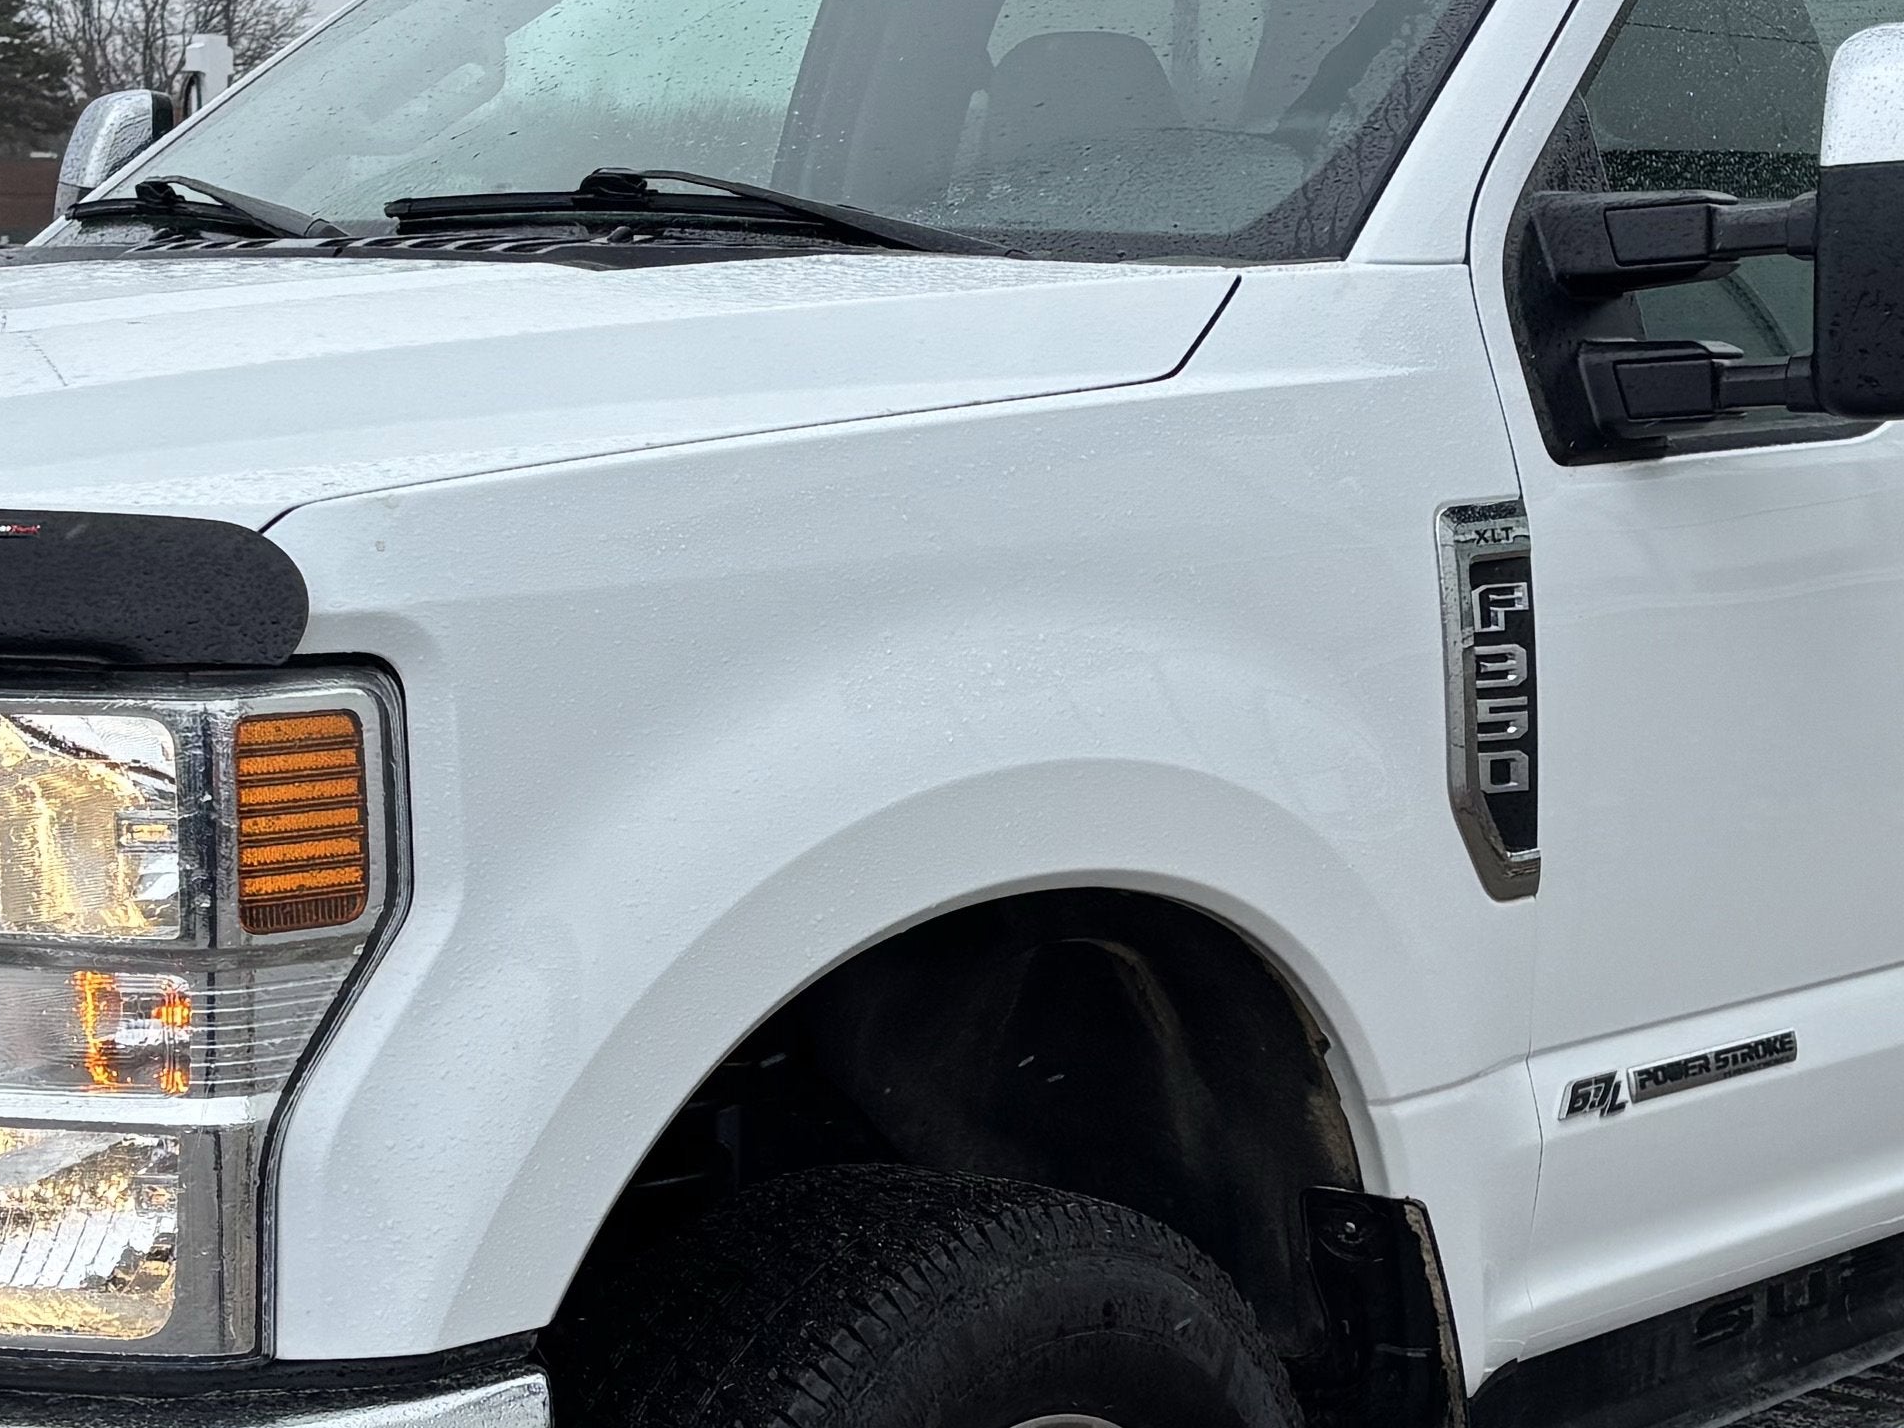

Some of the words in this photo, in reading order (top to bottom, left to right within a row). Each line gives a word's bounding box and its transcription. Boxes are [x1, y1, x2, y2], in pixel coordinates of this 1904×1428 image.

[1474, 526, 1515, 545] XLT
[1637, 1052, 1710, 1090] POWER
[1714, 1031, 1794, 1071] STROKE
